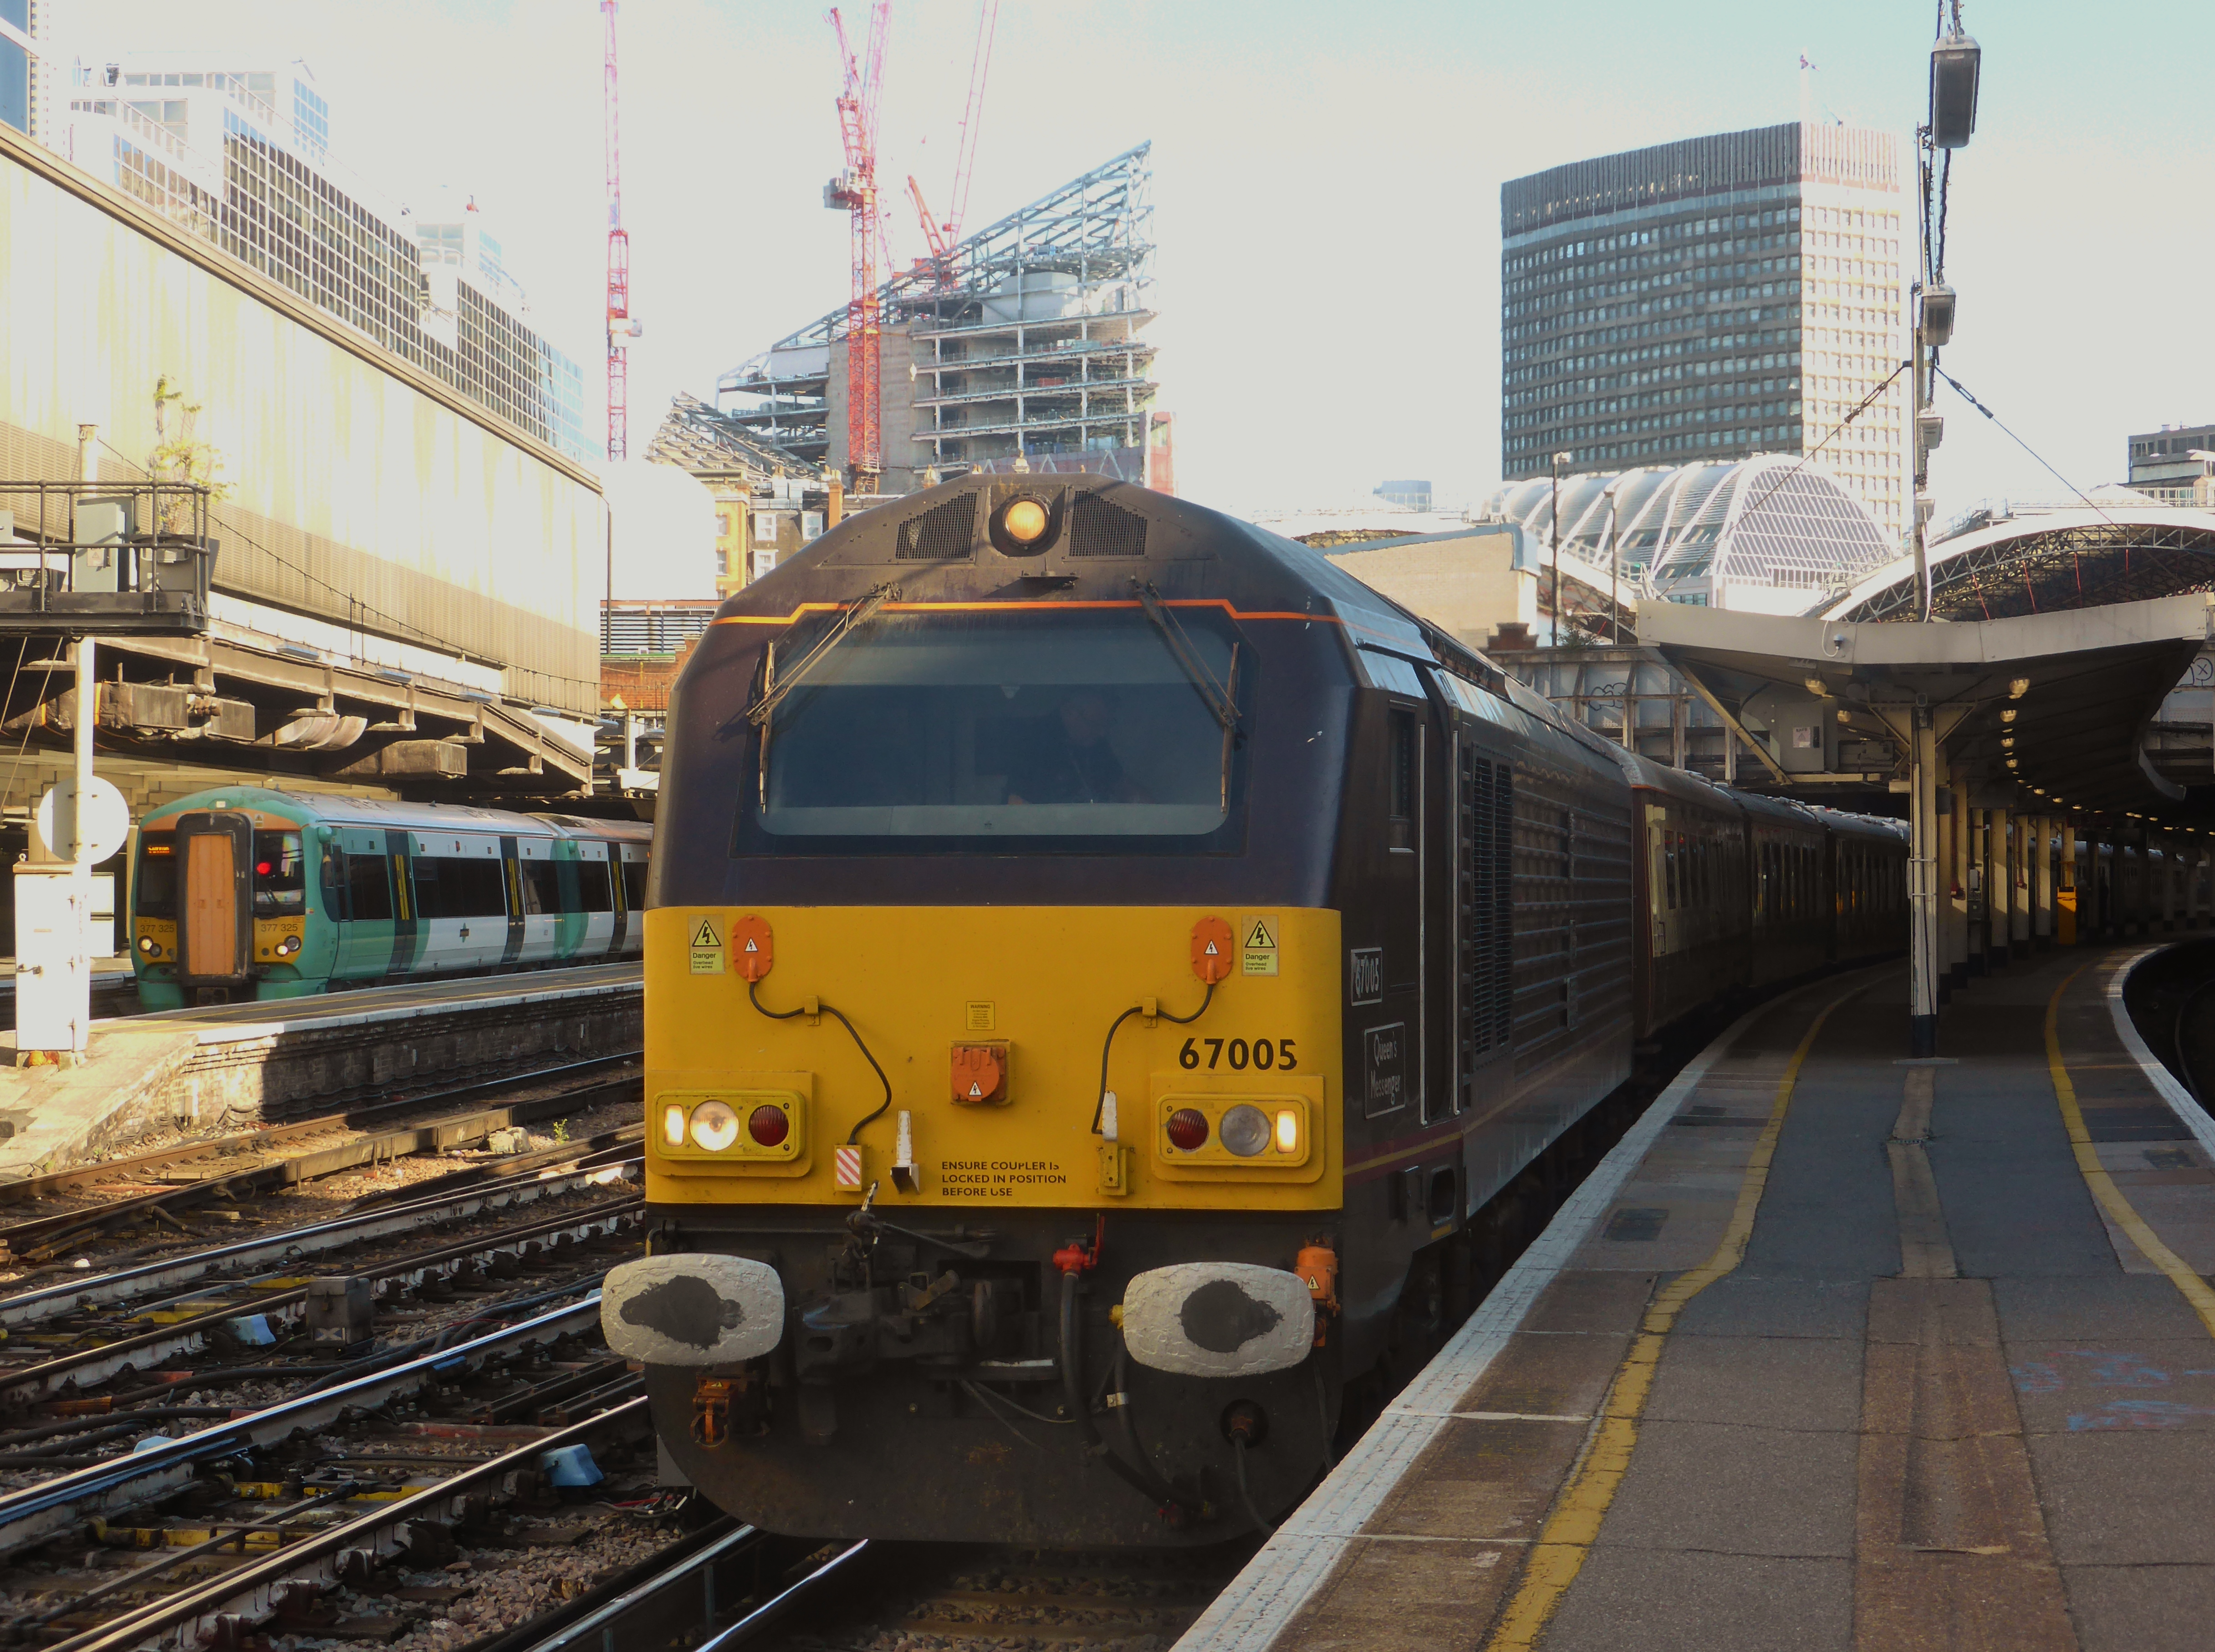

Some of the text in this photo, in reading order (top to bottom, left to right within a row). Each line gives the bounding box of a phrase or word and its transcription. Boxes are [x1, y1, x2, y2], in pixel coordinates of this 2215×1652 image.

[140, 924, 174, 933] 377 325
[281, 923, 298, 932] 325
[1355, 957, 1379, 996] 67005
[1373, 1031, 1397, 1067] Queen's
[1179, 1038, 1298, 1070] 67005
[1370, 1070, 1401, 1105] Messenger
[942, 1162, 987, 1170] ENSURE
[990, 1161, 1046, 1170] COUPLER
[942, 1175, 1066, 1183] LOCKED IN POSITION
[942, 1188, 1013, 1196] BEFORE USE
